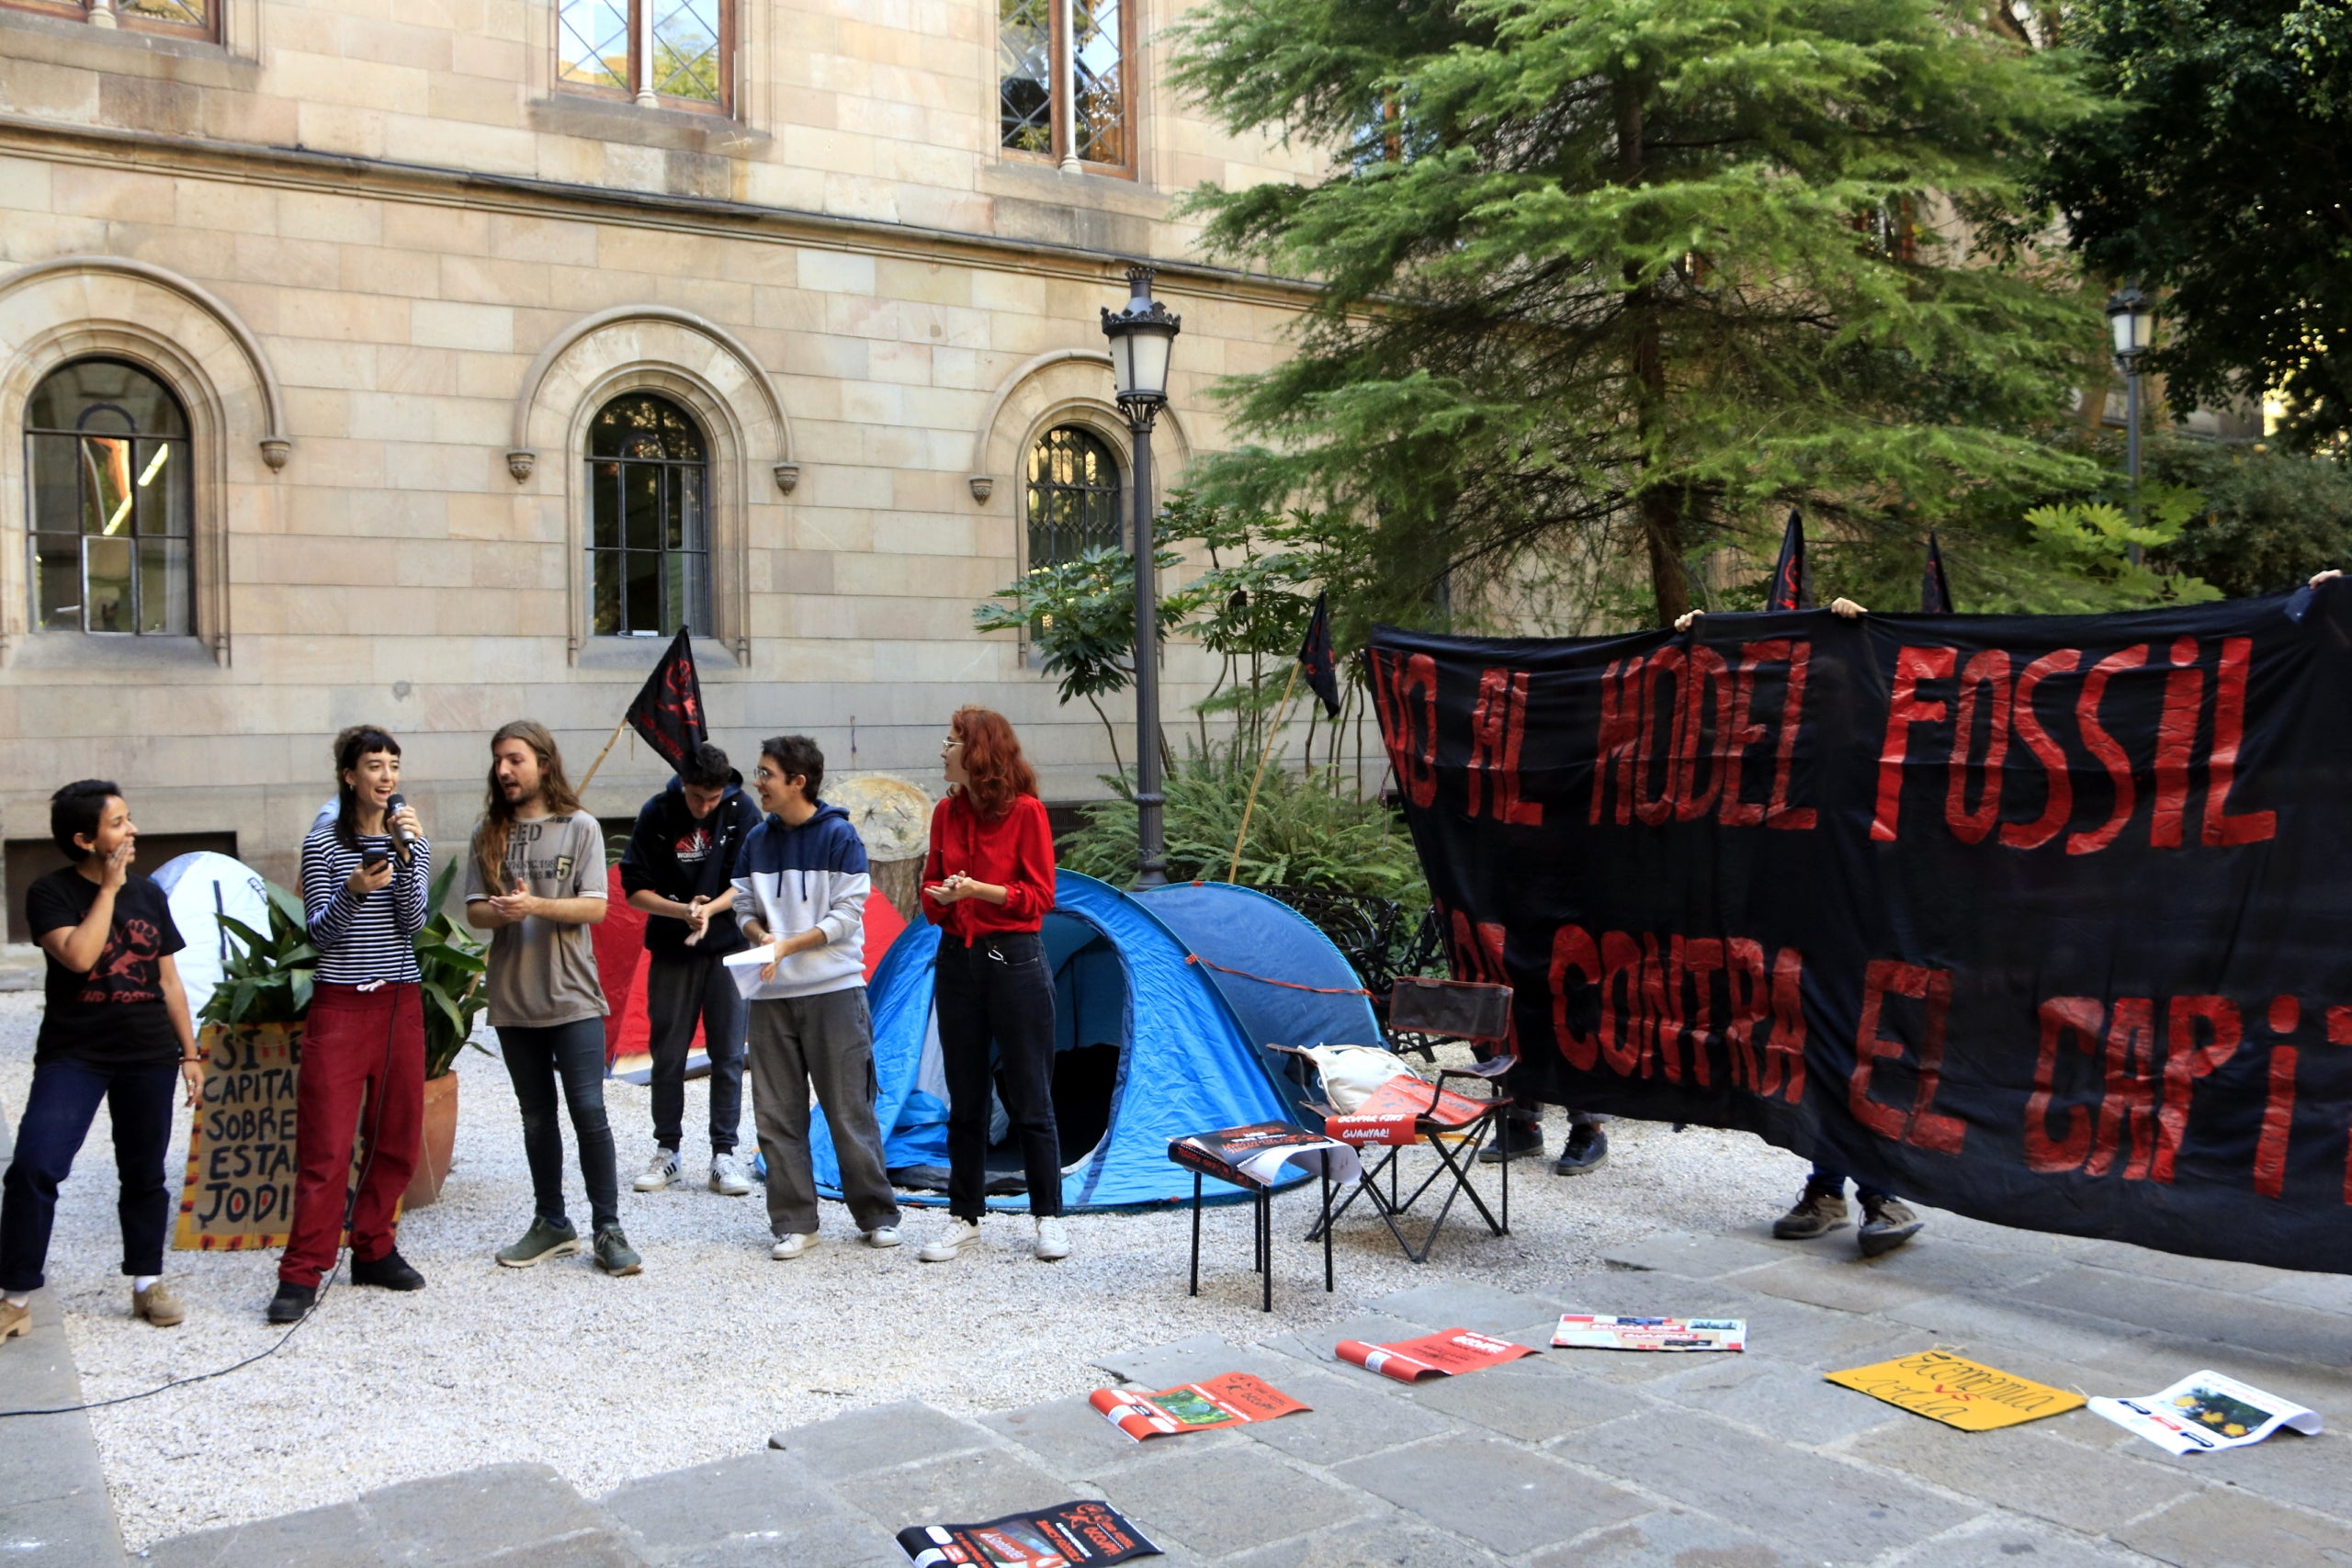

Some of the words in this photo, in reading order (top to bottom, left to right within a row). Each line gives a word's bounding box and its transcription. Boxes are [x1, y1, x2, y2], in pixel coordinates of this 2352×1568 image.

[1467, 667, 1544, 826] AL
[1589, 640, 1817, 830] MODEL
[506, 824, 543, 841] EED
[214, 1029, 262, 1071] SI
[1549, 924, 1807, 1104] CONTRA
[1849, 960, 1968, 1156] EL
[203, 1068, 299, 1106] CAPITA
[207, 1105, 298, 1141] SOBRE
[1342, 1128, 1389, 1138] GUANYAR!
[209, 1144, 300, 1182] ESTA
